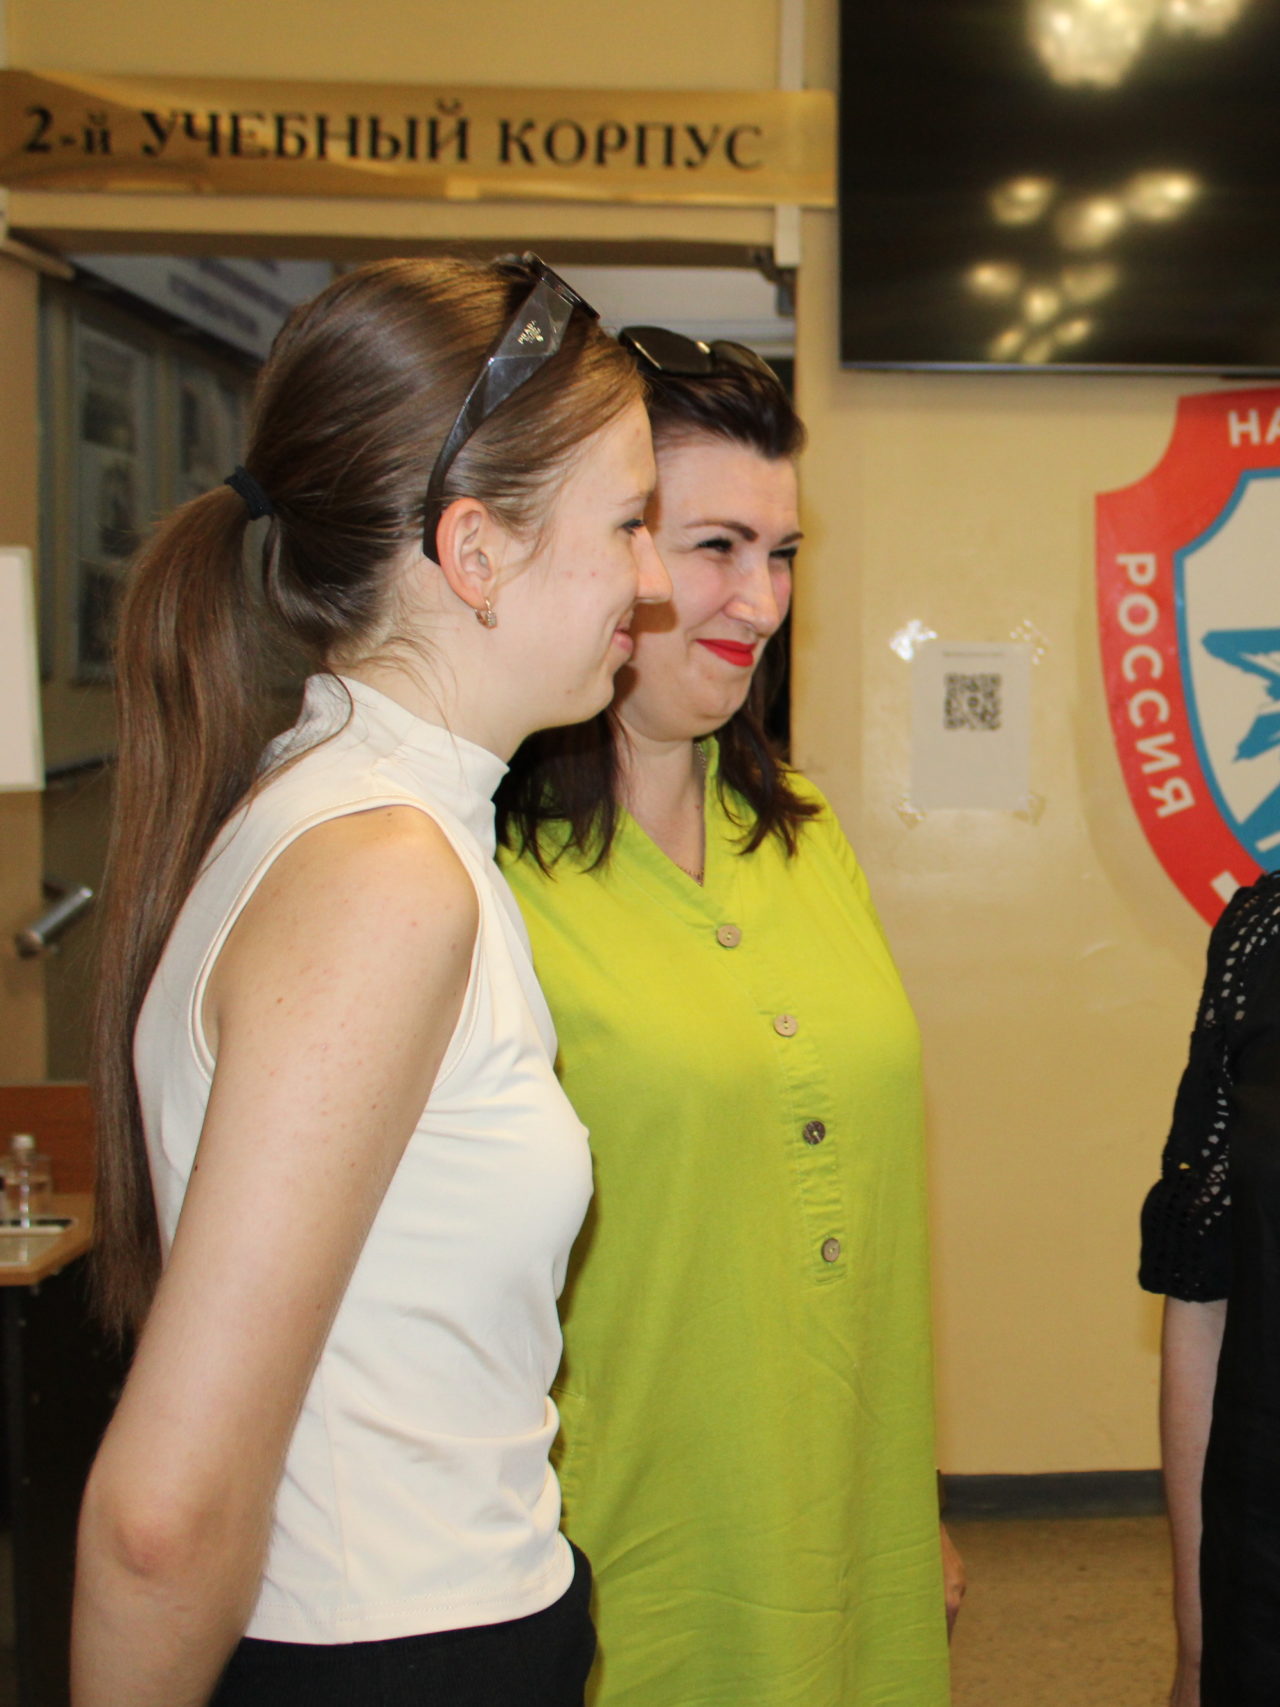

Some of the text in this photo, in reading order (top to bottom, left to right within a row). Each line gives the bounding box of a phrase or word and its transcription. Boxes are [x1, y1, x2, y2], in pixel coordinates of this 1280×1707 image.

[24, 99, 764, 171] 2-й УЧЕБНЫЙ КОРПУС
[1115, 553, 1195, 817] РОССИЯ
